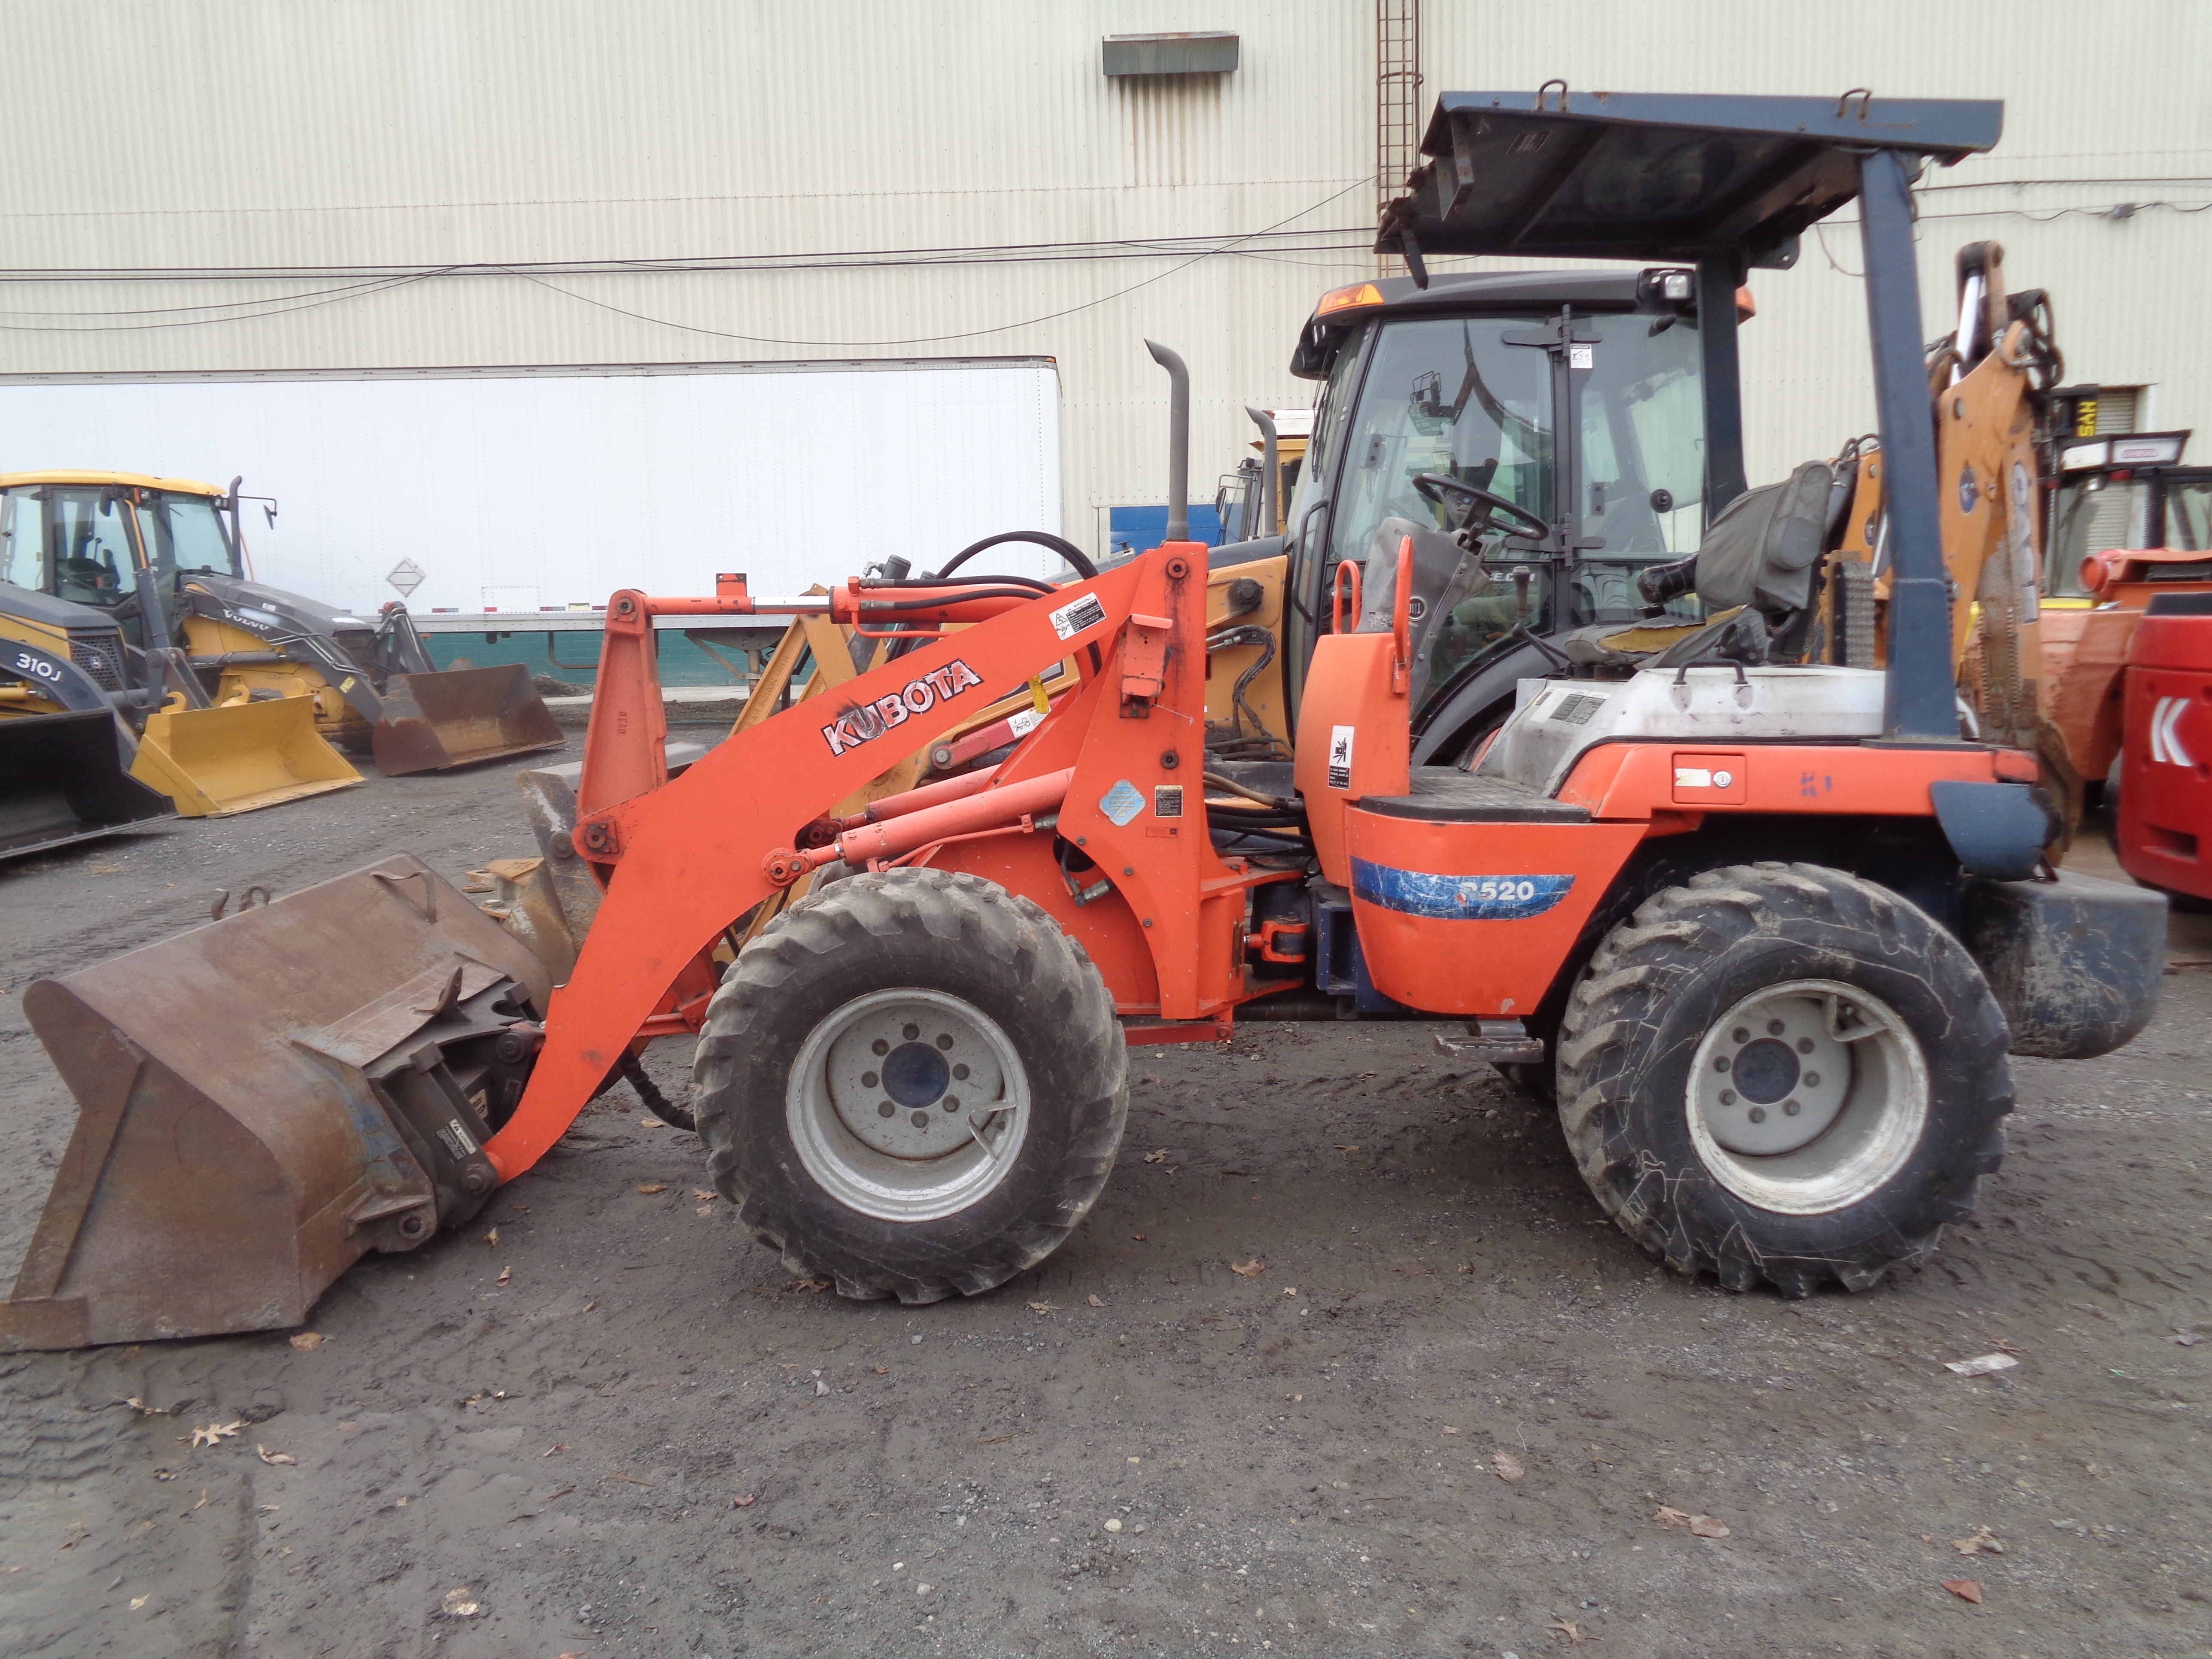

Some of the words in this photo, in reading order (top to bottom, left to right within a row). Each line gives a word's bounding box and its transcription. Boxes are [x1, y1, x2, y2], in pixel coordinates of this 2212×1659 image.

[223, 608, 269, 631] VOLVO
[16, 653, 61, 681] 310J
[820, 658, 985, 757] KUBOTA
